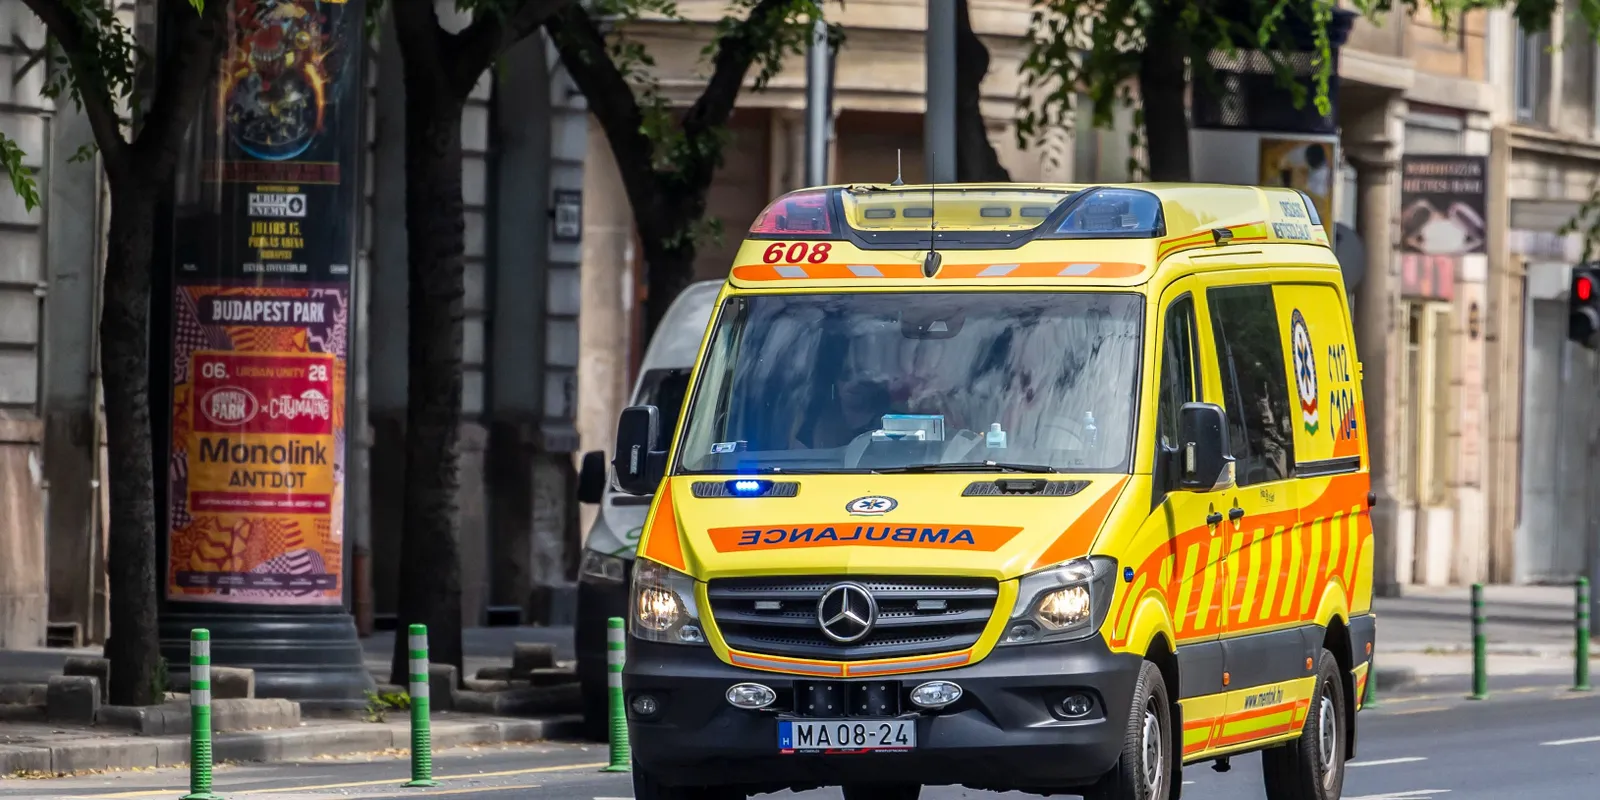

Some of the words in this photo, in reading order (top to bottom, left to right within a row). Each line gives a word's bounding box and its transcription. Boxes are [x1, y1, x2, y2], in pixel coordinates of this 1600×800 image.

[250, 194, 287, 203] PUBLIC
[250, 206, 287, 216] ENEMY
[763, 242, 832, 264] 608
[212, 300, 291, 322] BUDAPEST
[293, 302, 325, 323] PARK
[202, 363, 230, 379] 06.
[235, 366, 274, 378] URBAN
[276, 367, 305, 379] UNITY
[212, 403, 246, 420] PARK
[200, 438, 327, 465] Monolink
[229, 470, 307, 488] ANTDOT
